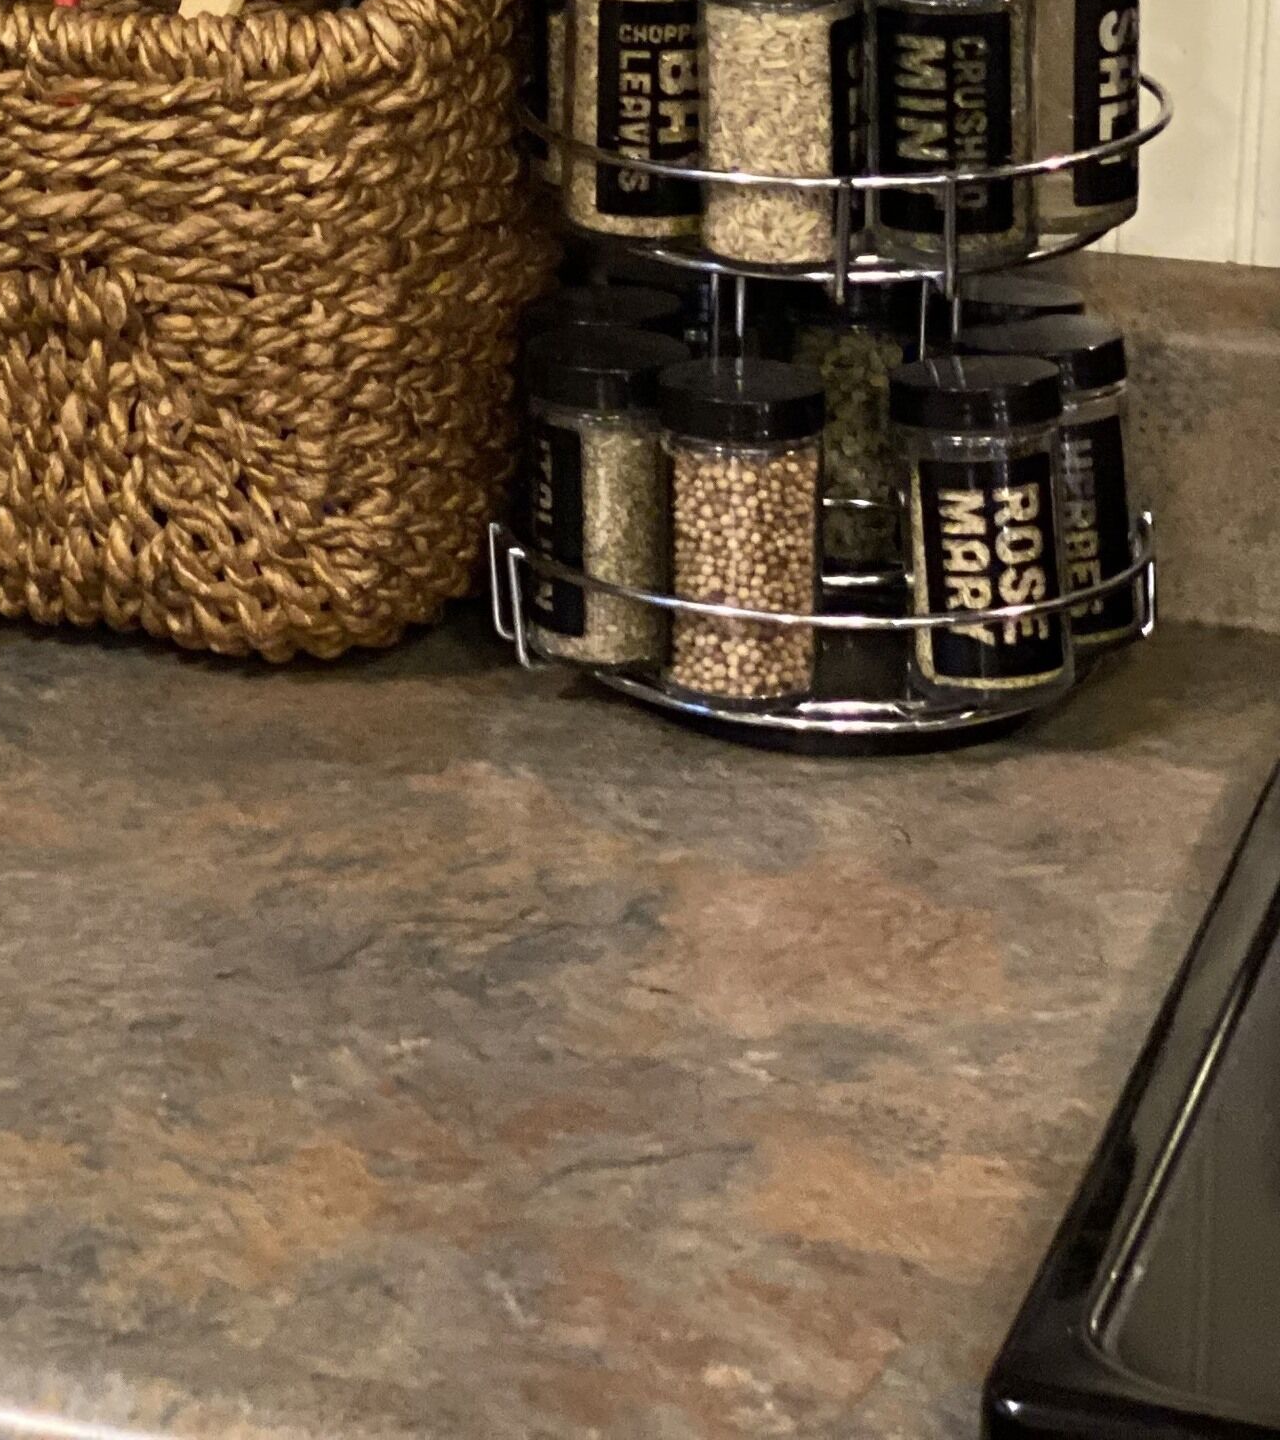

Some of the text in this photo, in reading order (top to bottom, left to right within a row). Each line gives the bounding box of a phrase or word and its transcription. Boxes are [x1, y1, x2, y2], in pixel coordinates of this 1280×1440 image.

[618, 23, 698, 45] CHOPP
[1098, 8, 1139, 166] SAL
[657, 49, 702, 177] BA
[992, 482, 1050, 646] ROSE
